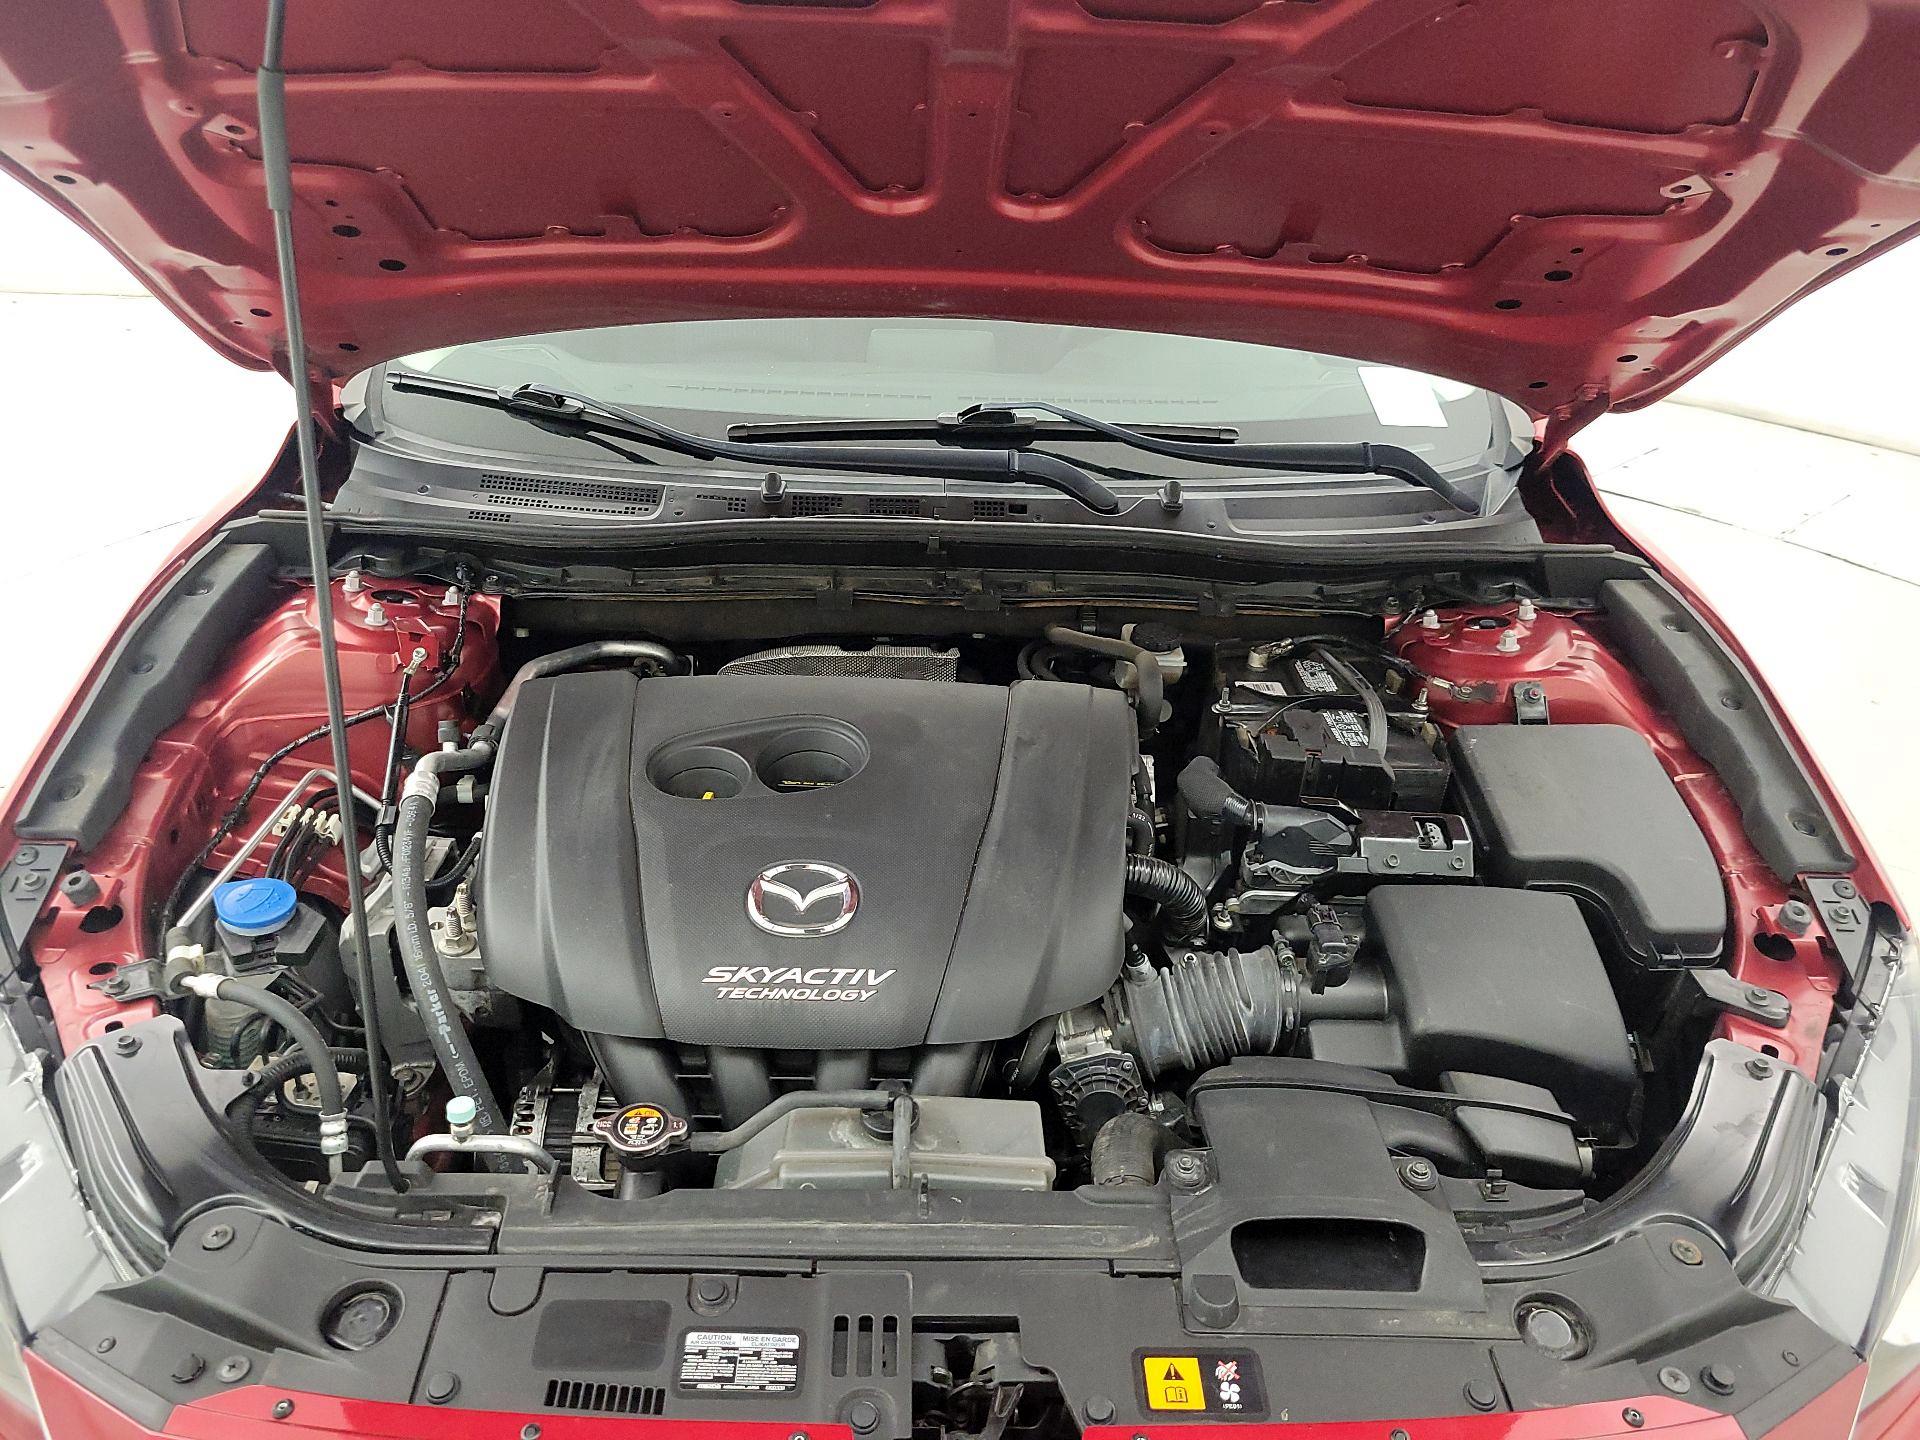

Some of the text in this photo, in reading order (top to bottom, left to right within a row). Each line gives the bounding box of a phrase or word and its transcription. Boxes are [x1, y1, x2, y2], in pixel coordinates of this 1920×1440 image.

[411, 935, 424, 961] 16mm
[416, 962, 432, 987] 2041
[701, 966, 897, 986] SKYACTIV
[716, 987, 879, 1002] TECHNOLOGY
[427, 988, 451, 1035] Parker
[455, 1061, 474, 1089] EPDM
